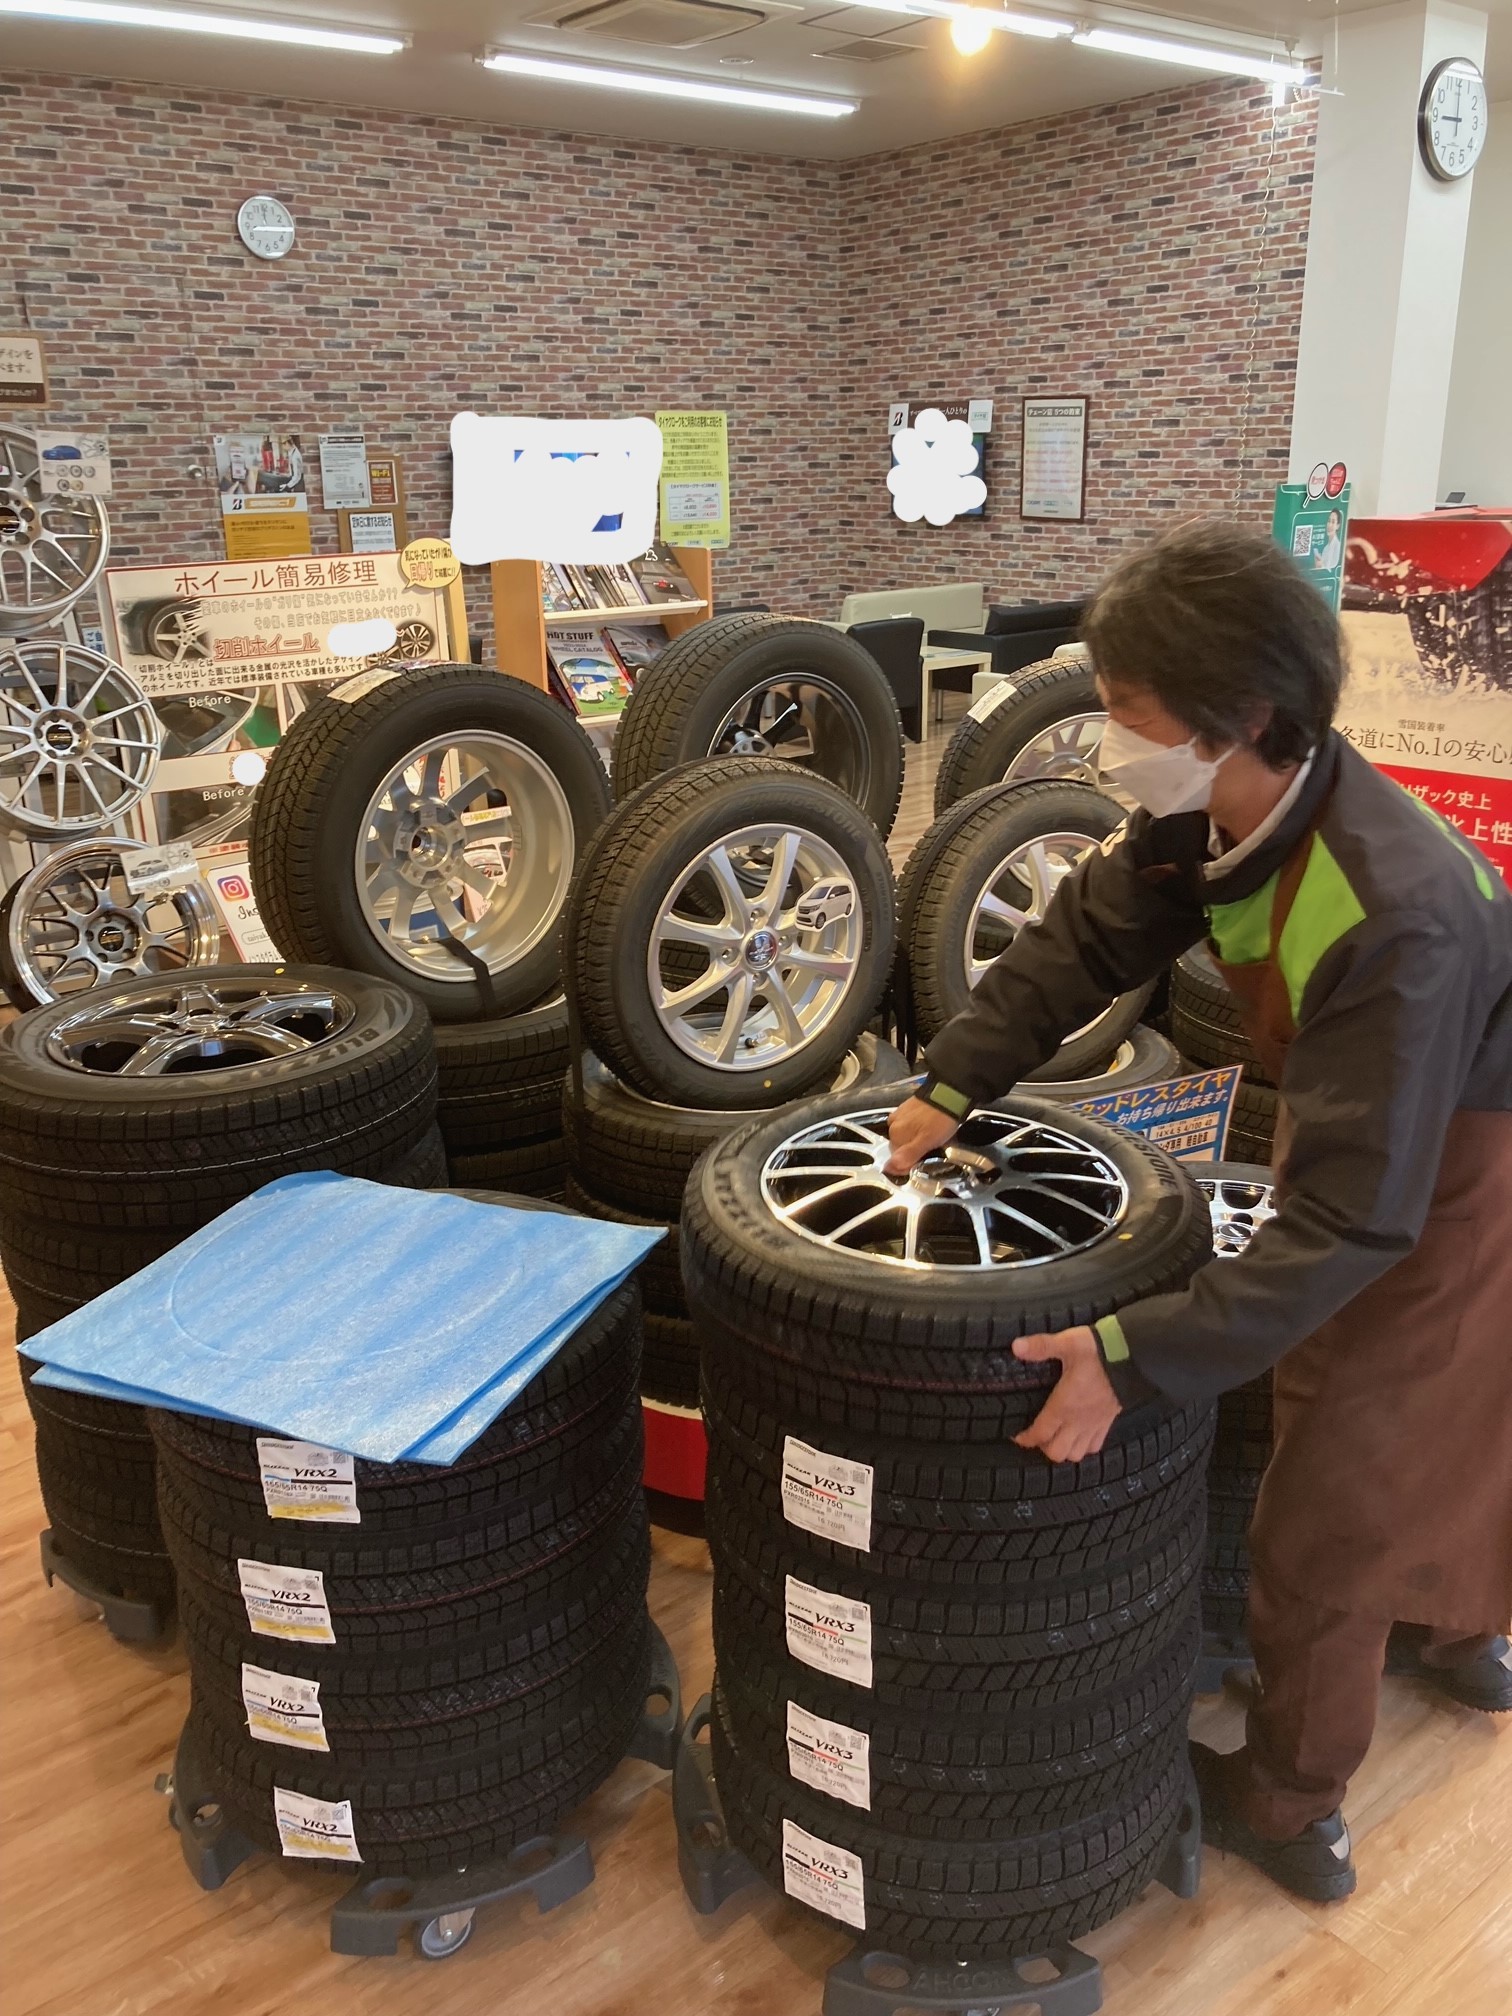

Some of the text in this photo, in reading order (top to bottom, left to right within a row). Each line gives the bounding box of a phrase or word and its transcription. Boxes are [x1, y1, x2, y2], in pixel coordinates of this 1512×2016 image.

[174, 559, 378, 597] ホイール簡易修理
[214, 632, 320, 659] 切削ホイール
[566, 632, 594, 640] STUFF
[188, 695, 232, 708] Before
[1339, 725, 1512, 765] 冬道にNo.1の安心
[202, 787, 244, 802] Before
[1080, 1071, 1232, 1117] タッドレスタイヤ
[1114, 1089, 1229, 1125] お持ち帰り出来ます。
[294, 1468, 337, 1478] VRX2
[785, 1481, 843, 1510] 155/65R14 75Q
[814, 1475, 856, 1496] VRX3
[272, 1590, 311, 1602] VRX2
[789, 1618, 845, 1646] 155/65R14 75Q
[815, 1612, 856, 1633] VRX3
[270, 1697, 305, 1712] VRX2
[815, 1738, 853, 1760] VRX3
[303, 1818, 338, 1833] VRX2
[811, 1857, 849, 1880] VRX3
